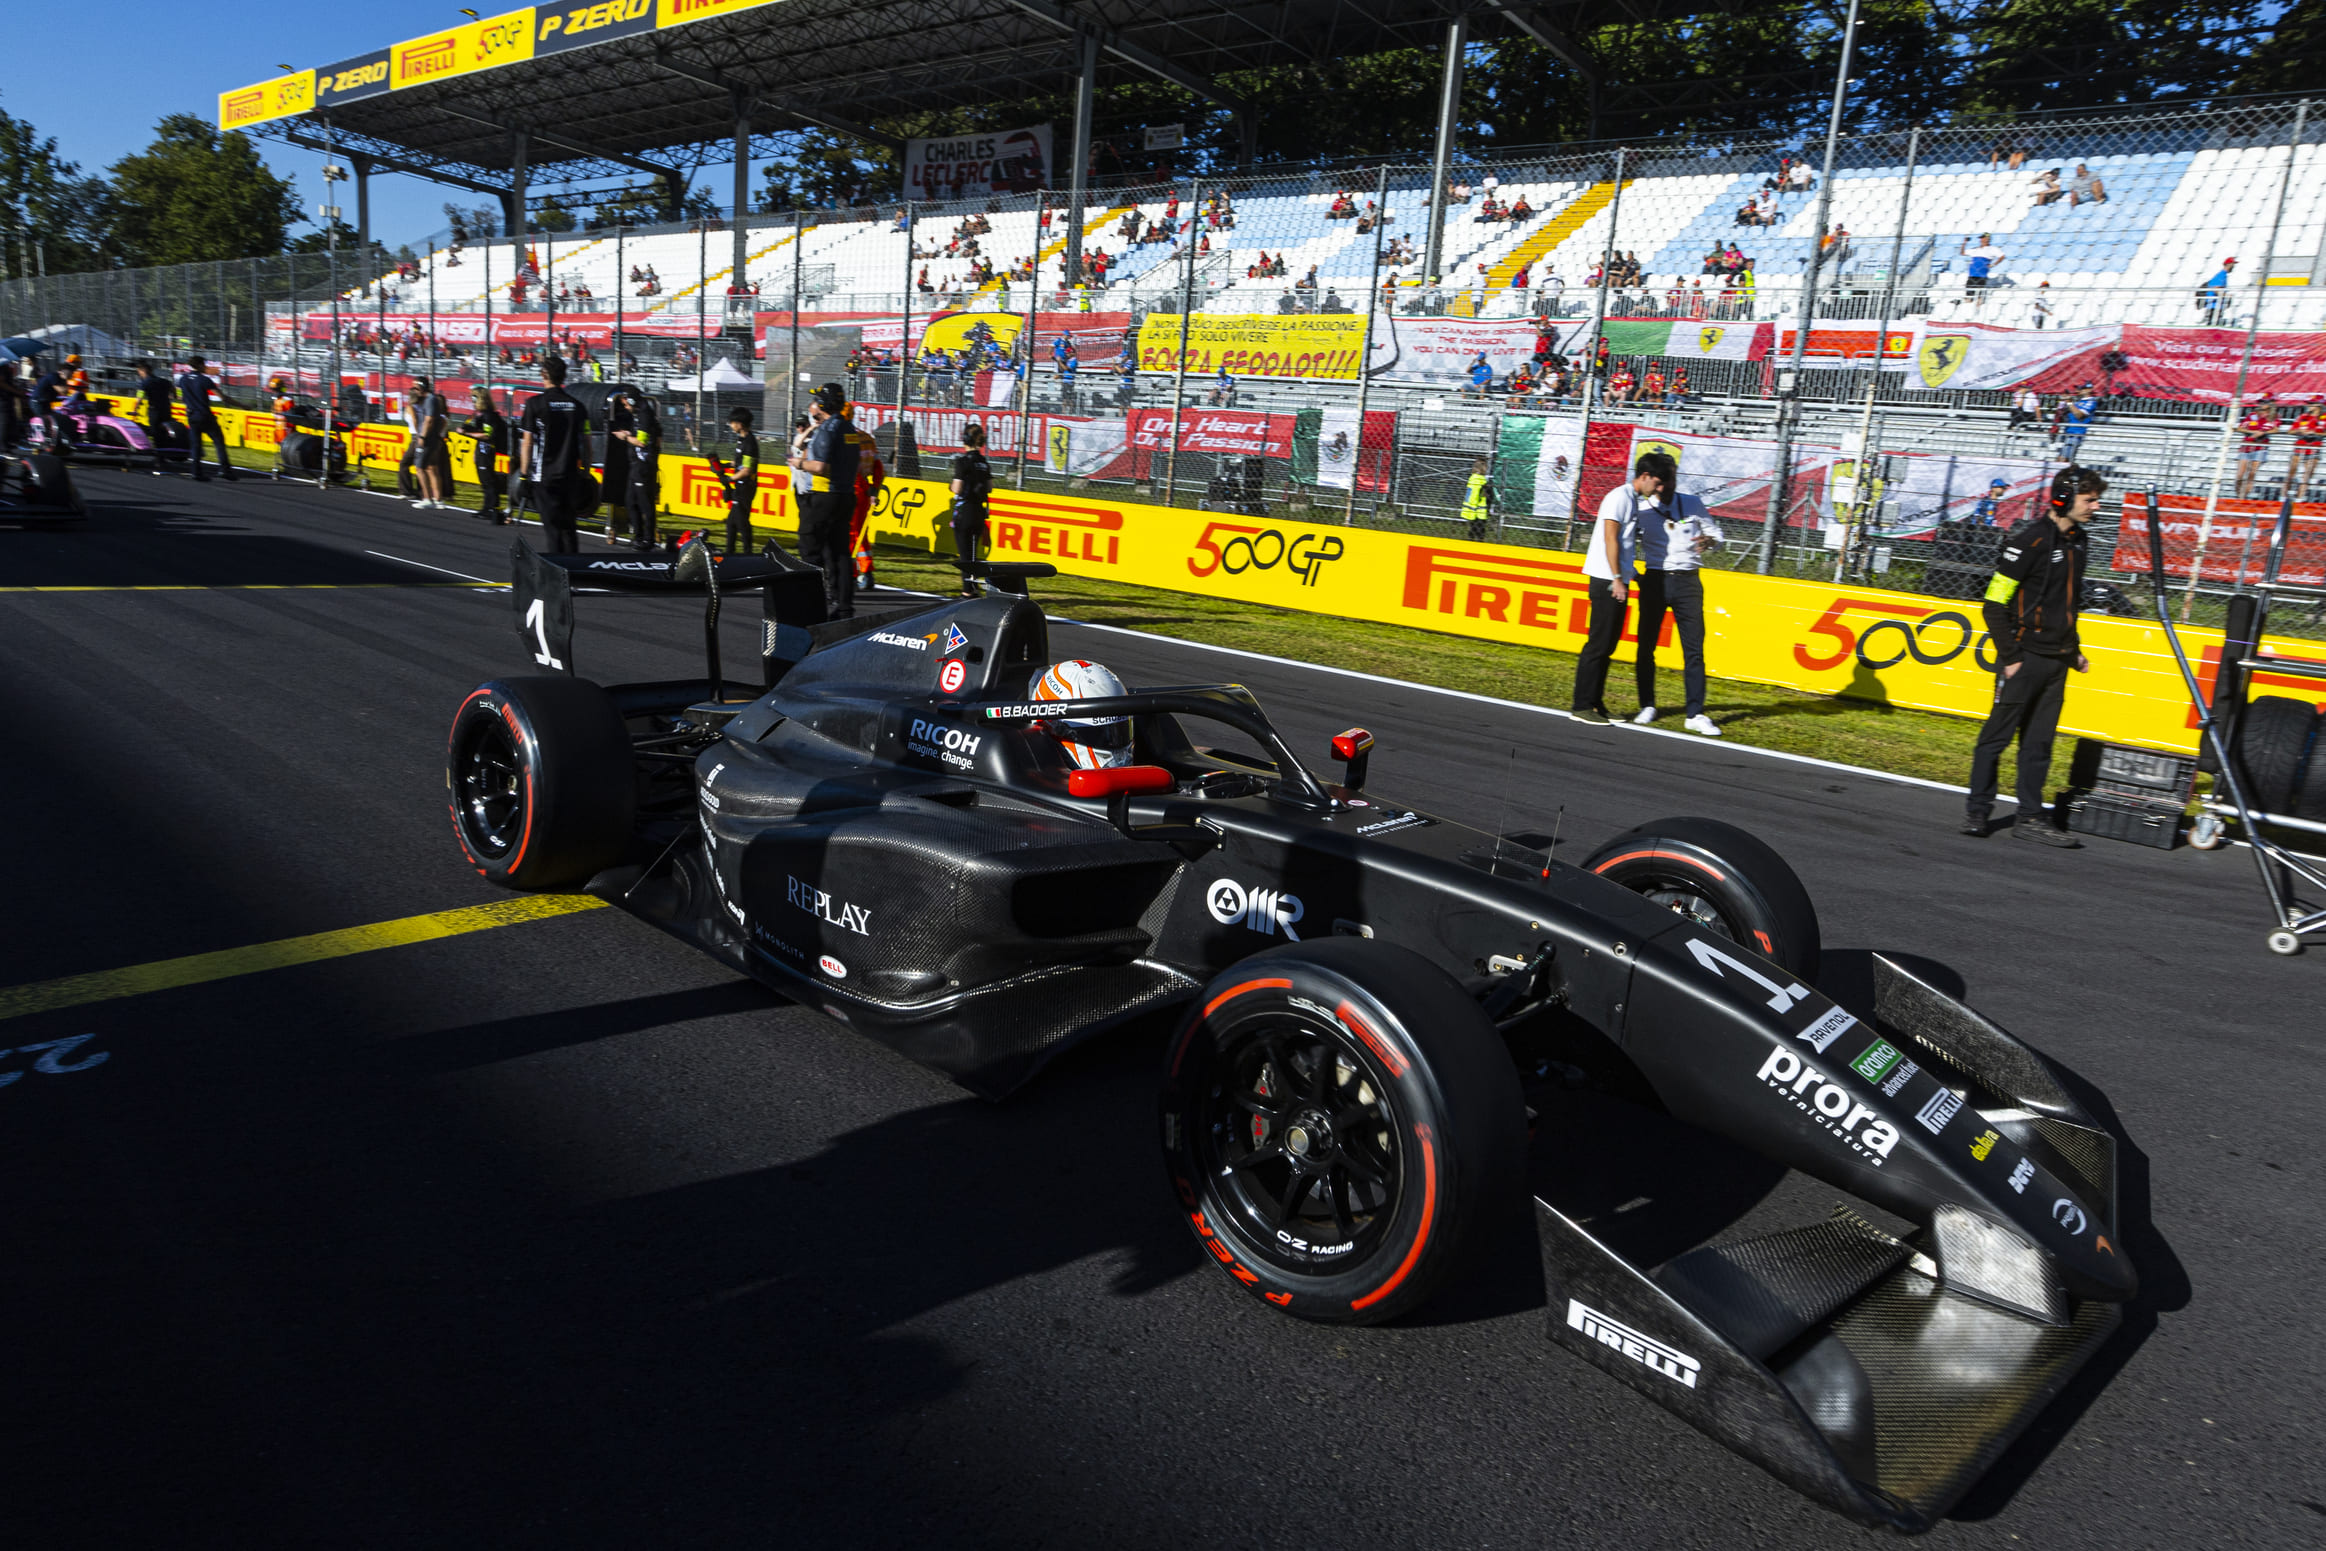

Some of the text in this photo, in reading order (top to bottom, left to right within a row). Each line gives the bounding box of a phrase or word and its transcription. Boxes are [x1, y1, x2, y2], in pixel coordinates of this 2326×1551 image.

[538, 15, 562, 41] P
[401, 38, 455, 79] PIRELLI
[317, 60, 389, 96] P ZERO
[925, 138, 995, 163] CHARLES
[912, 160, 992, 187] LECLERC
[1437, 336, 1456, 344] THE
[1196, 417, 1271, 435] Heart
[1183, 433, 1281, 453] Passion
[526, 598, 563, 671] 1
[867, 631, 927, 651] McLaren
[946, 666, 960, 686] E
[1046, 675, 1063, 696] RICOH
[910, 718, 981, 756] RICOH
[907, 739, 974, 770] imagine. change.
[787, 873, 872, 937] REPLAY
[764, 931, 805, 961] MONOLITH
[821, 958, 843, 975] BELL
[1685, 938, 1811, 1014] 1
[1808, 1009, 1851, 1044] RAVENOL
[1857, 1043, 1897, 1078] aramco
[1756, 1044, 1900, 1159] prora
[1914, 1087, 1964, 1136] PIRELLI
[1768, 1079, 1883, 1167] verniciatura
[1176, 1176, 1294, 1307] P ZERO
[1311, 1241, 1354, 1255] RACING
[1566, 1297, 1701, 1389] PIRELLI
